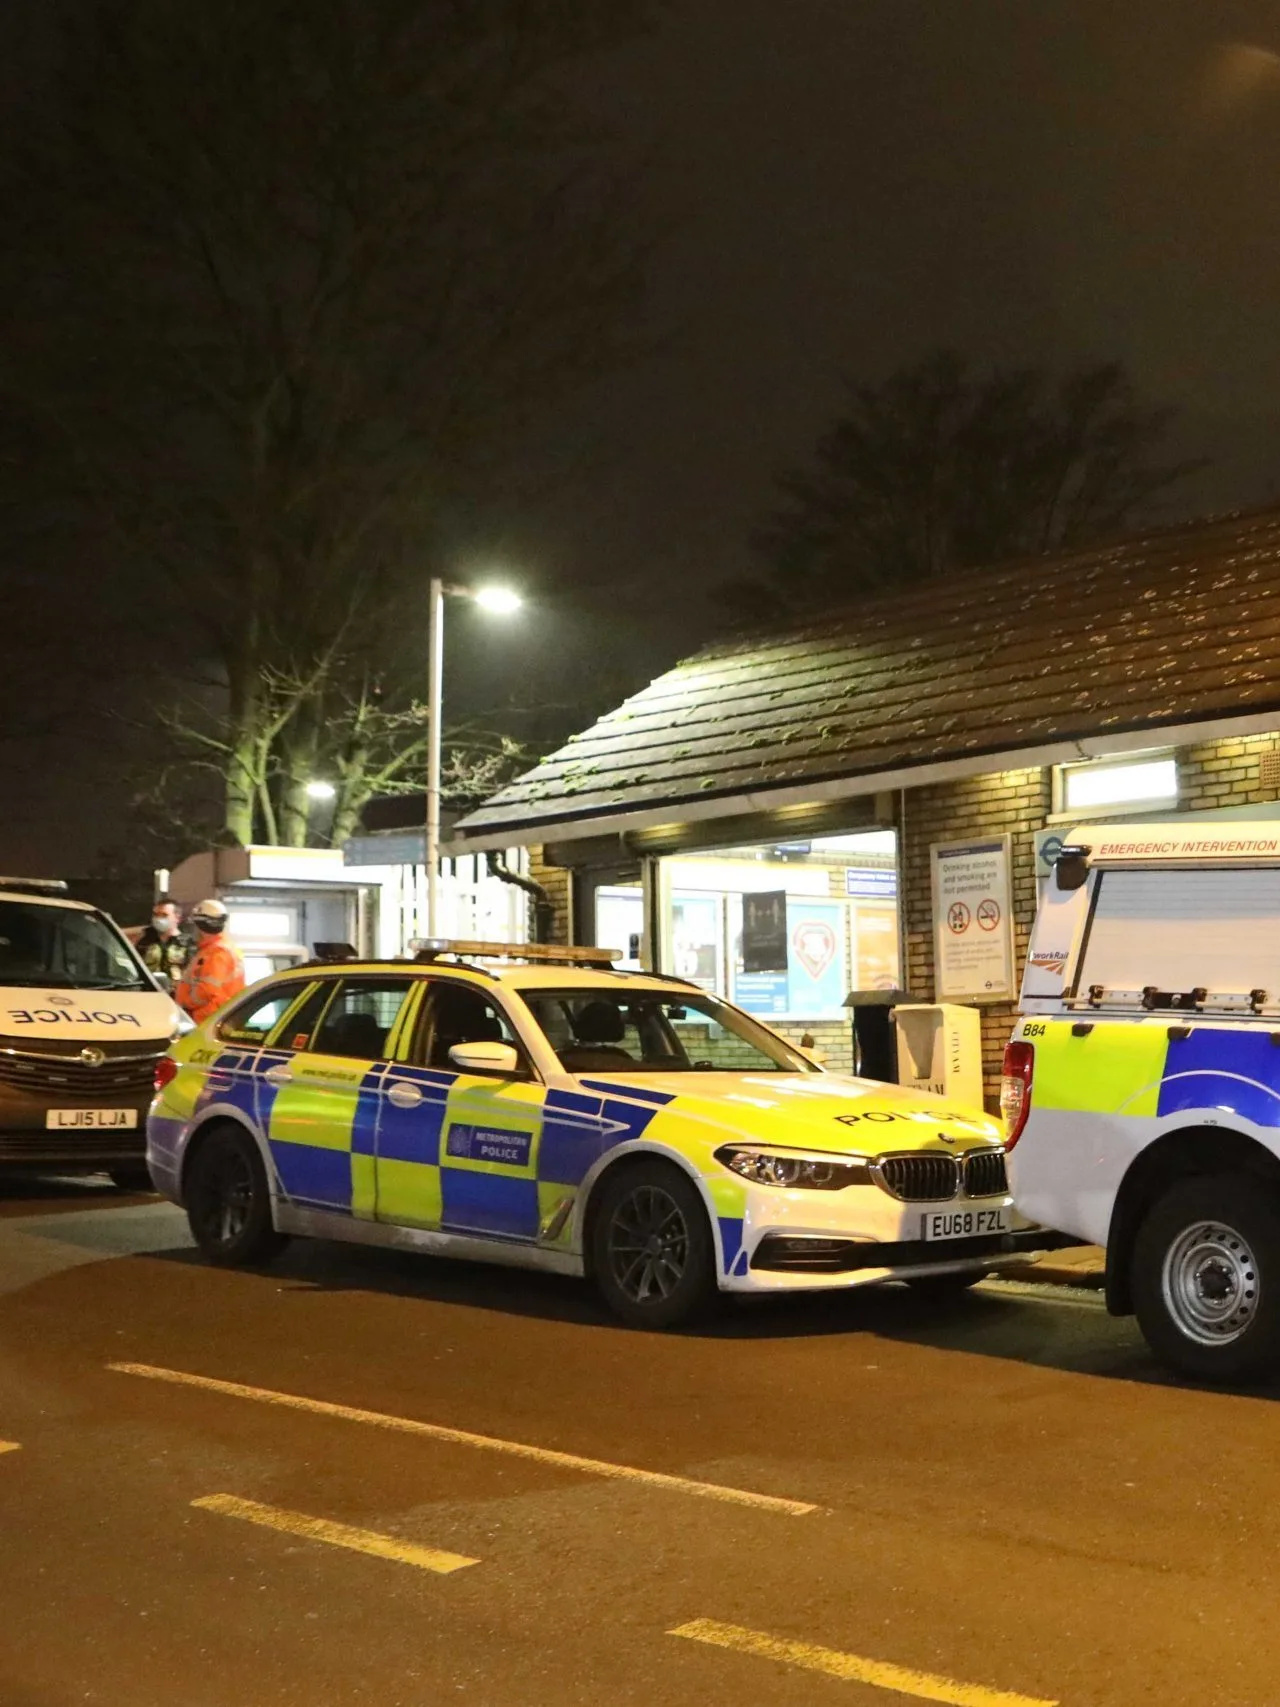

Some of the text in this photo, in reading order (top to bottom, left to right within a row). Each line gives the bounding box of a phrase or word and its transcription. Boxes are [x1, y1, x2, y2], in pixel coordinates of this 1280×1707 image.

[1100, 842, 1179, 854] EMERGENCY
[1181, 841, 1278, 853] INTERVENTION
[1022, 1024, 1046, 1037] B84
[58, 1111, 128, 1126] LJ15 LJA
[475, 1131, 528, 1146] METROPOLITAN
[481, 1145, 518, 1160] POLICE
[932, 1210, 1006, 1237] EU68 FZL
